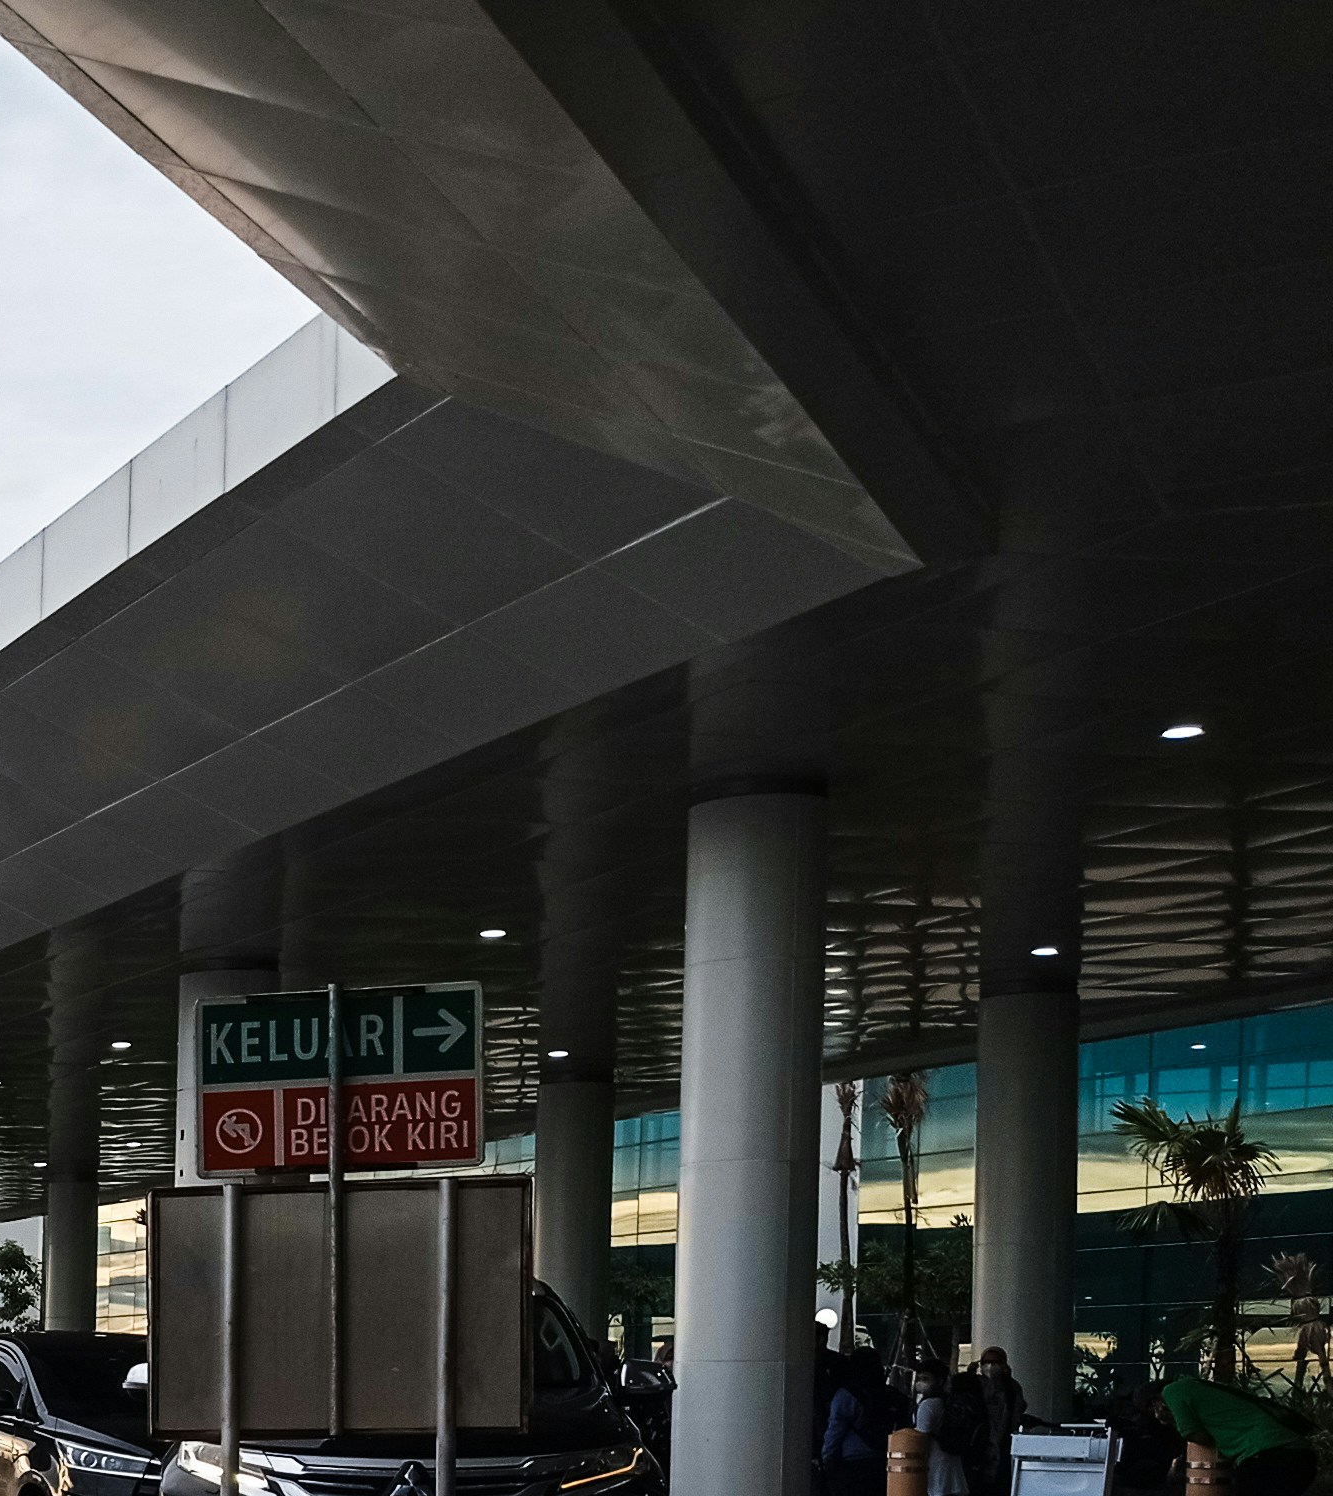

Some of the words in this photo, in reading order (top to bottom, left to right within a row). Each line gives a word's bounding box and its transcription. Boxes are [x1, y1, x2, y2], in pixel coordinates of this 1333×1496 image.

[297, 1090, 461, 1126] DIARANG
[291, 1123, 393, 1156] BEOK
[407, 1120, 469, 1151] KIRI
